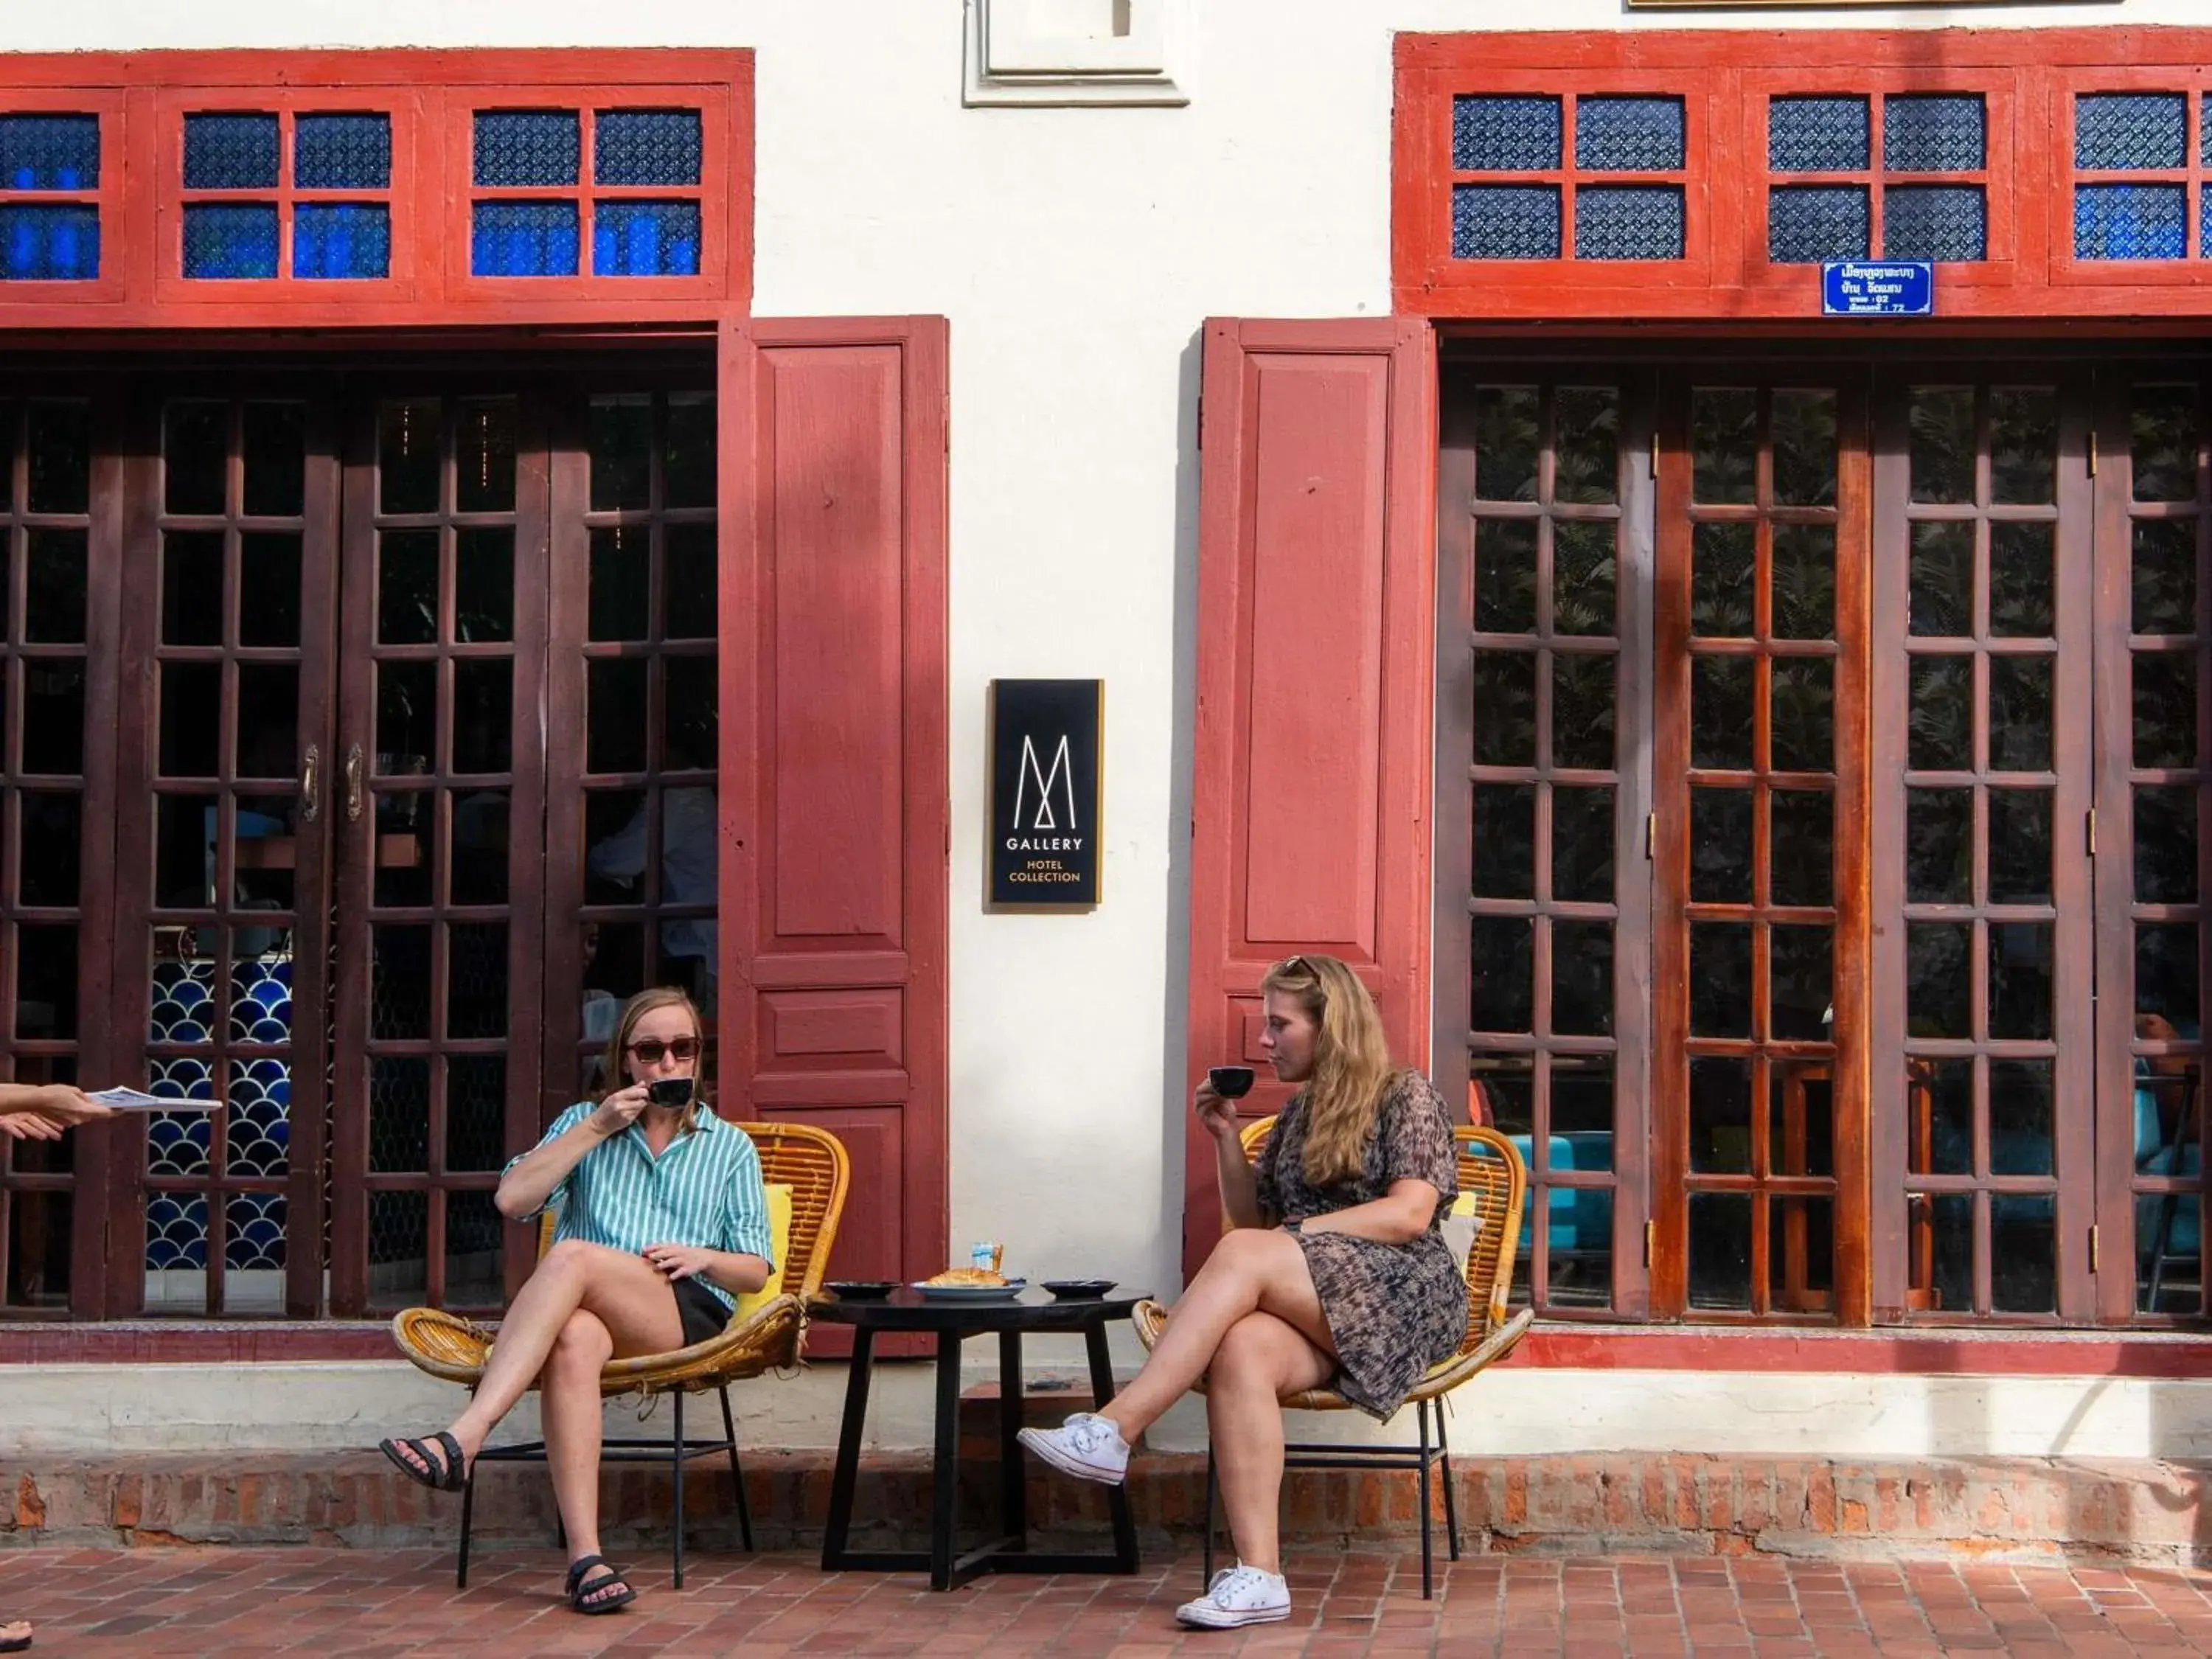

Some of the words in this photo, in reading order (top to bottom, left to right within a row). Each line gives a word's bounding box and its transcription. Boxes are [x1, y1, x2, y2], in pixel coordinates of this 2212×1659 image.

[1006, 838, 1082, 850] GALLERY
[1026, 860, 1062, 870] HOTEL
[1009, 872, 1080, 883] COLLECTION
